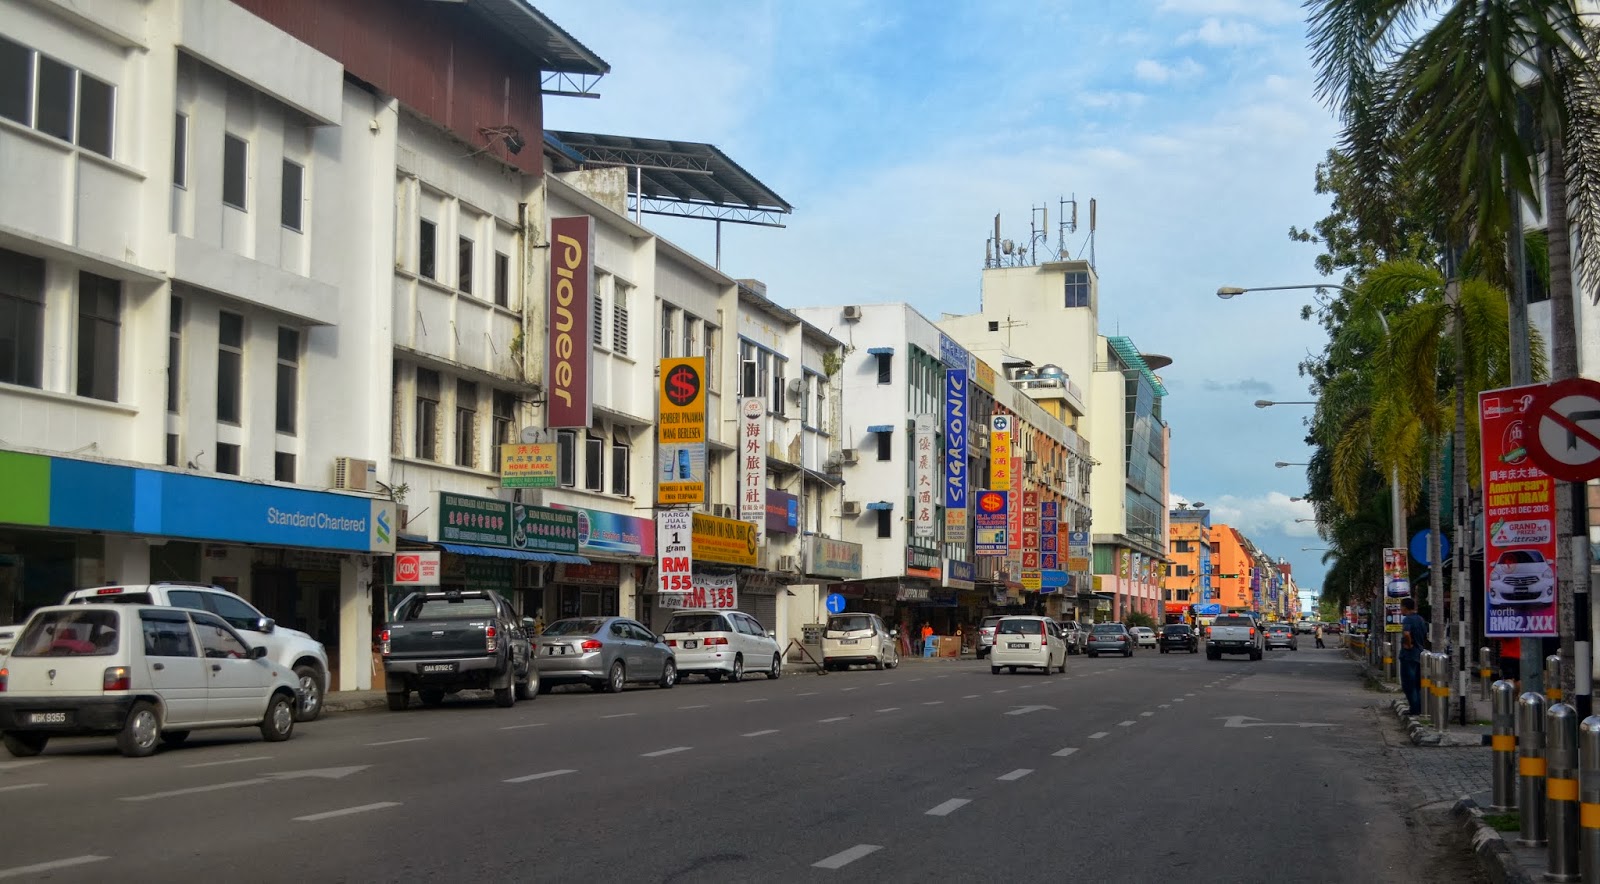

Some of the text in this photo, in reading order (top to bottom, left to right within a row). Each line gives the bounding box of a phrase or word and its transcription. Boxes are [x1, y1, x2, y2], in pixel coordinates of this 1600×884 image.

[555, 234, 582, 408] Pioneer
[663, 428, 676, 439] WANG
[948, 375, 965, 502] SAGASONIC
[746, 424, 761, 503] 海外旅行社
[1489, 480, 1548, 494] Anniversary
[1489, 491, 1548, 506] LUCKY DRAW
[268, 507, 365, 532] Standard Chartered
[1489, 508, 1497, 516] 04
[1509, 523, 1537, 531] GRAND
[672, 532, 680, 544] 1
[666, 545, 686, 553] gram
[662, 556, 689, 572] RM
[914, 552, 927, 567] NIPPON
[400, 563, 416, 574] KDK
[661, 575, 692, 590] 155
[710, 587, 734, 608] 155
[1490, 607, 1515, 616] worth
[1490, 616, 1553, 632] RM62,XXX
[46, 713, 66, 722] 9355
